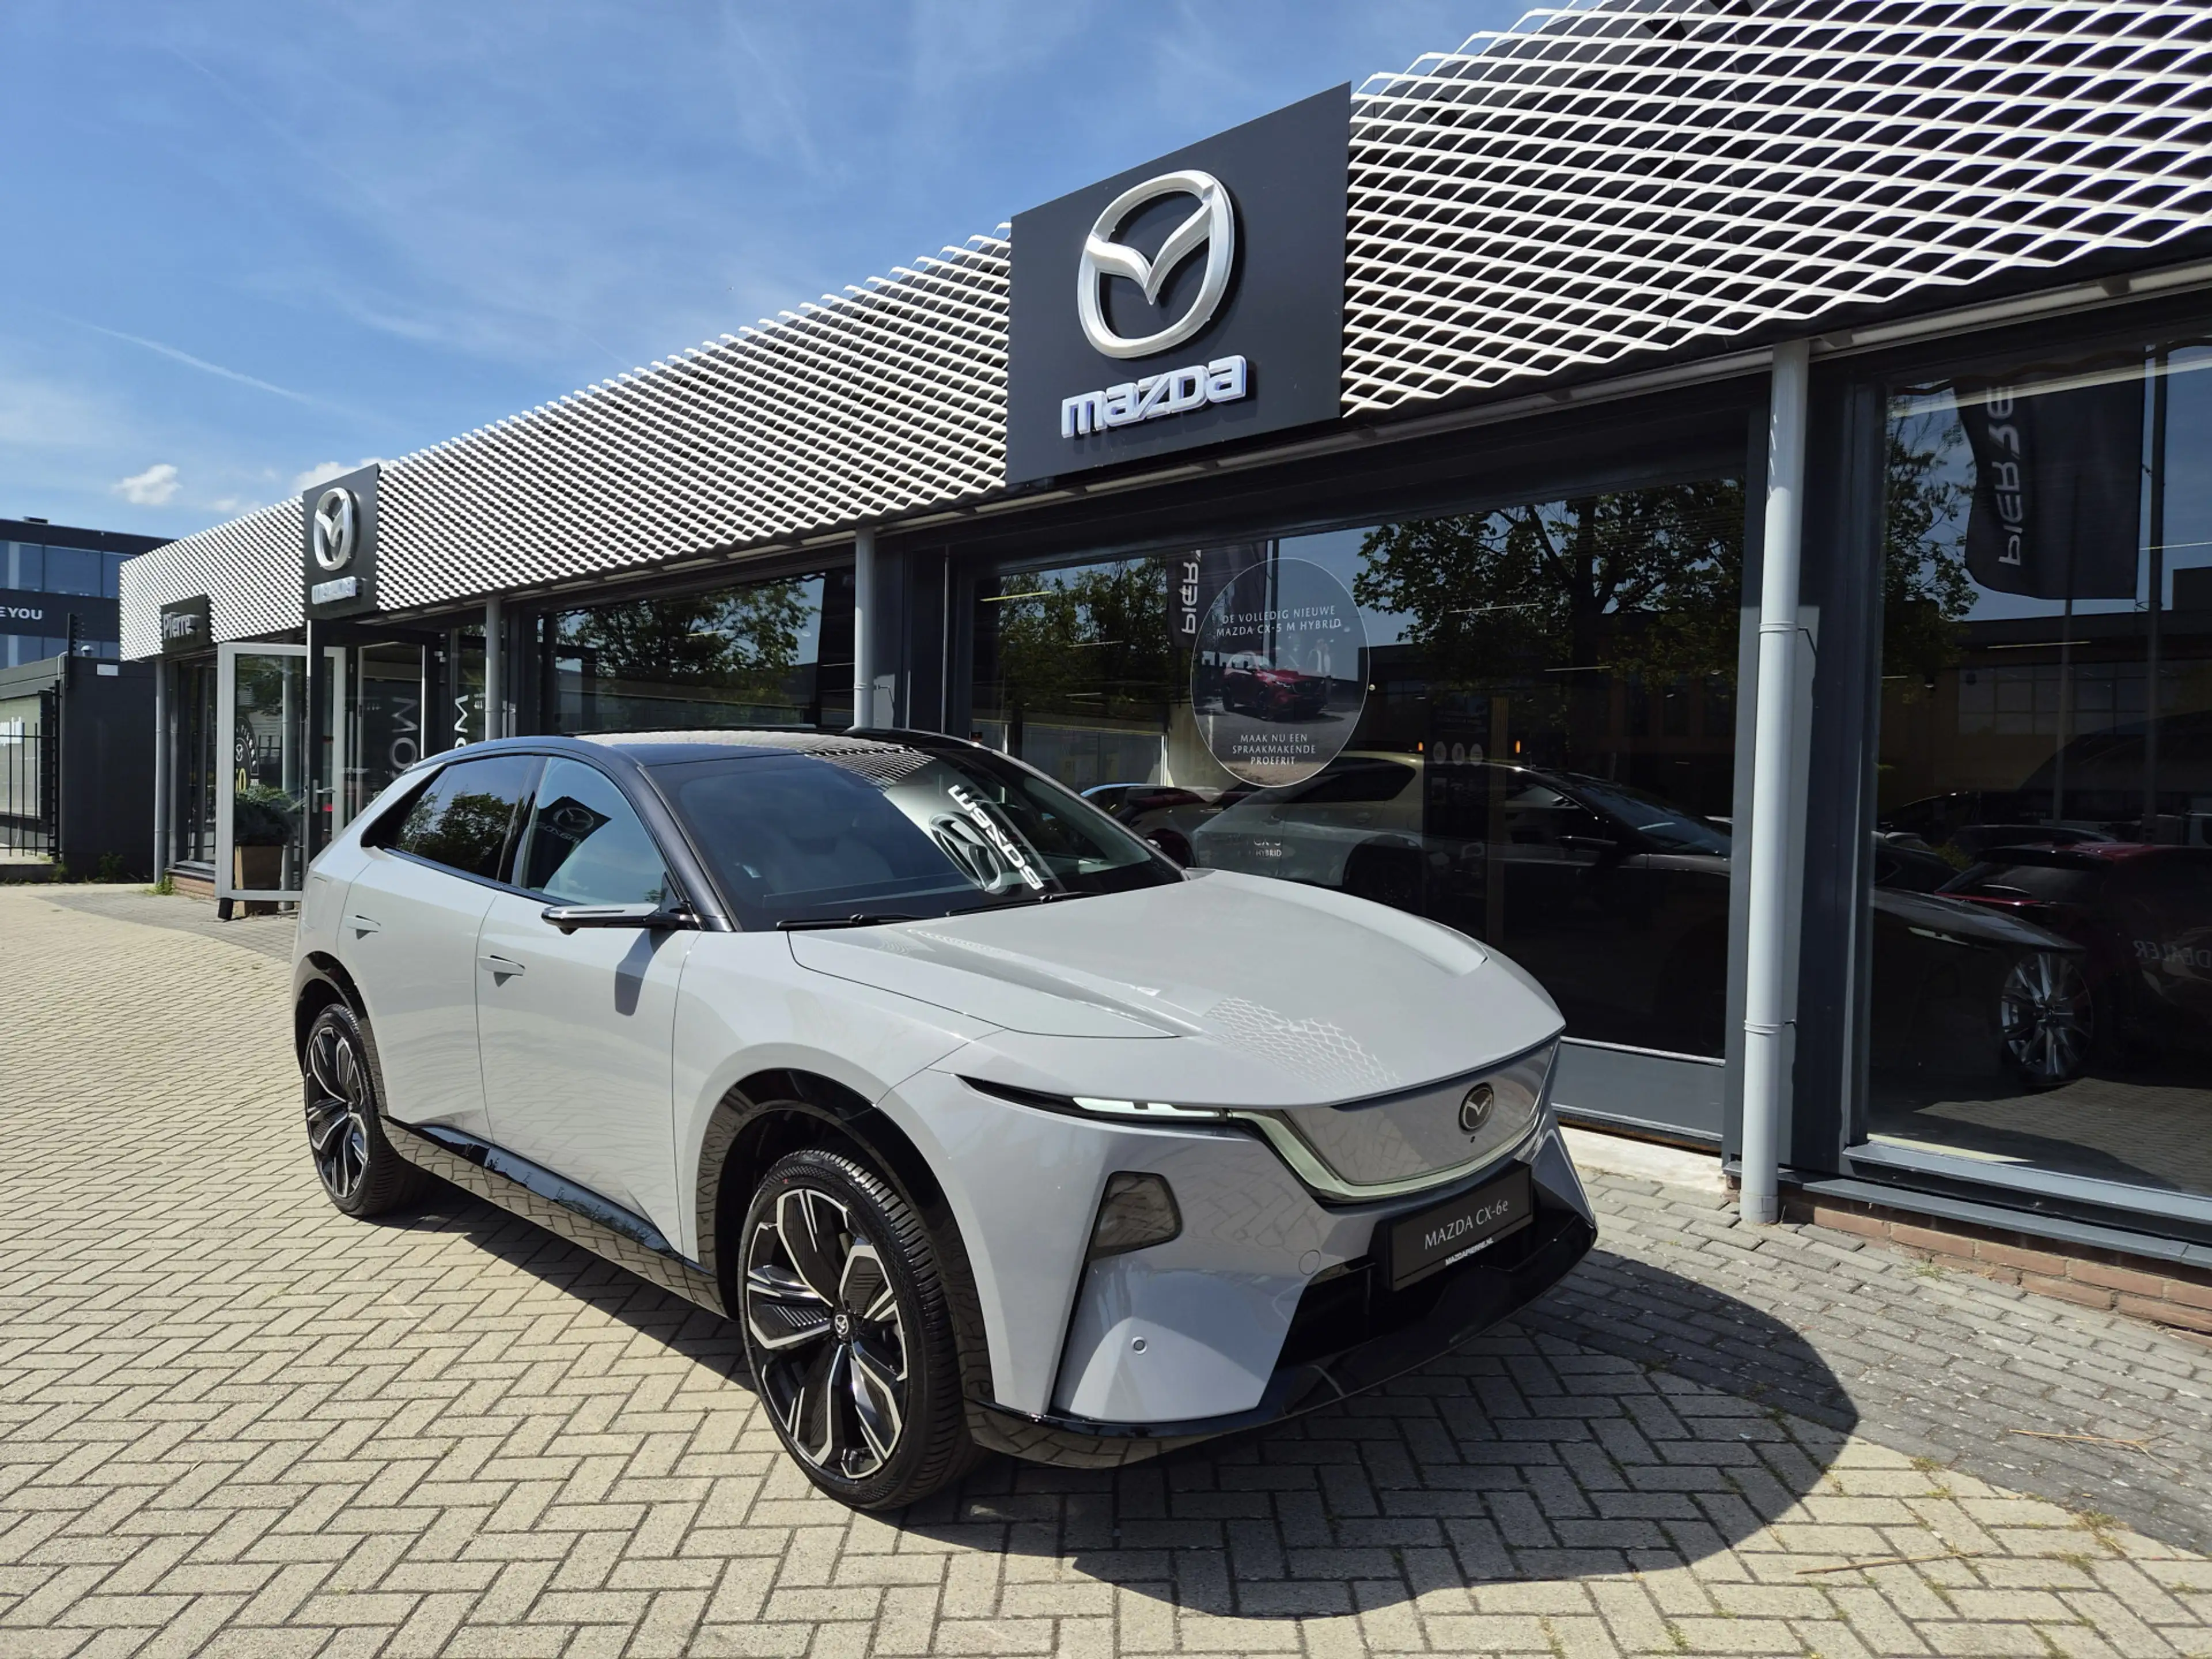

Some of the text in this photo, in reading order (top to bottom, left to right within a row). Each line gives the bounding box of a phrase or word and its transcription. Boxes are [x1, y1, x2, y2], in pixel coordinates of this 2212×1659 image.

[1222, 605, 1335, 624] DE VOLLEDIG NIEUWE
[1217, 619, 1341, 637] MAZDA CX-5 M HYBRID
[1240, 734, 1308, 743] MAAK NU EEN
[1232, 745, 1316, 754] SPRAAKMAKENDE
[1251, 756, 1296, 765] PROEFRIT
[1425, 1199, 1509, 1250] MAZDA CX-6e
